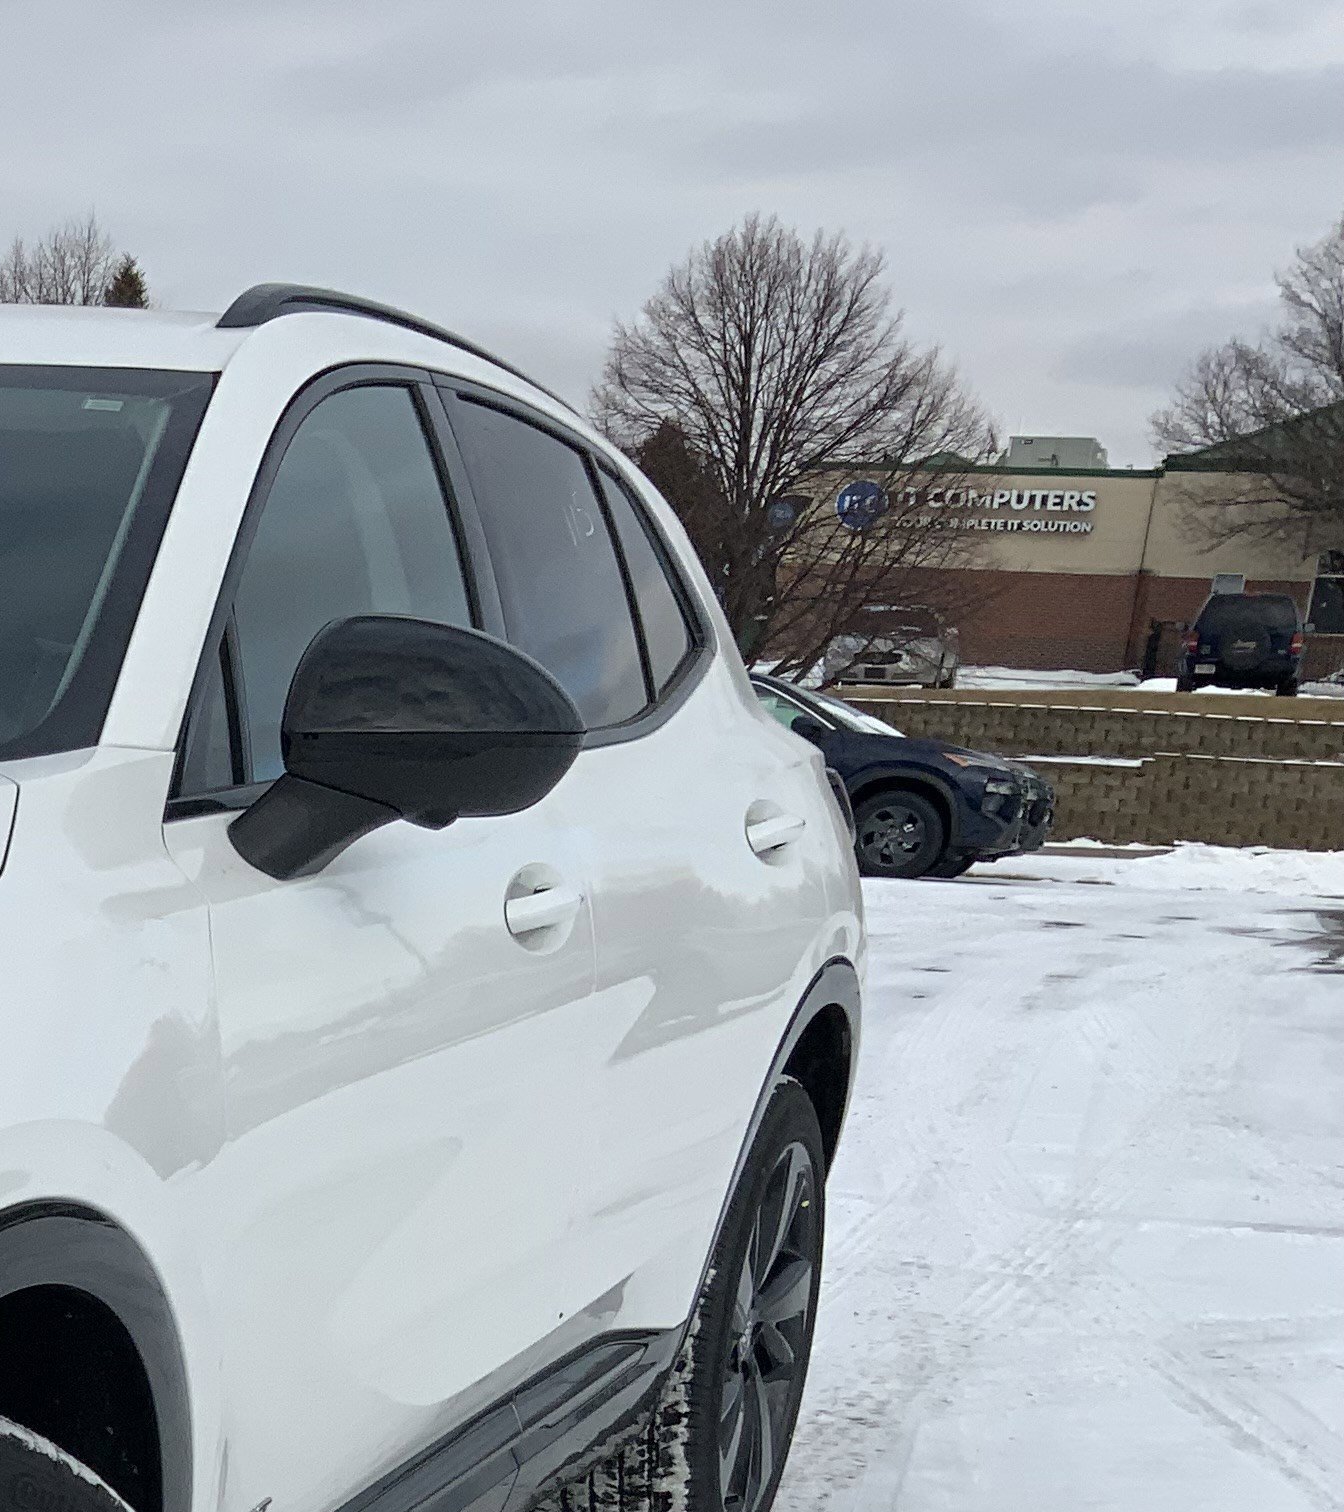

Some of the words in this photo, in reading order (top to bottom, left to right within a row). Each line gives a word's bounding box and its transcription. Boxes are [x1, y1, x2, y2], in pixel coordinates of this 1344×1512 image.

[927, 487, 1097, 512] COMPUTERS
[1007, 519, 1021, 531] IT
[1021, 519, 1094, 533] SOLUTION
